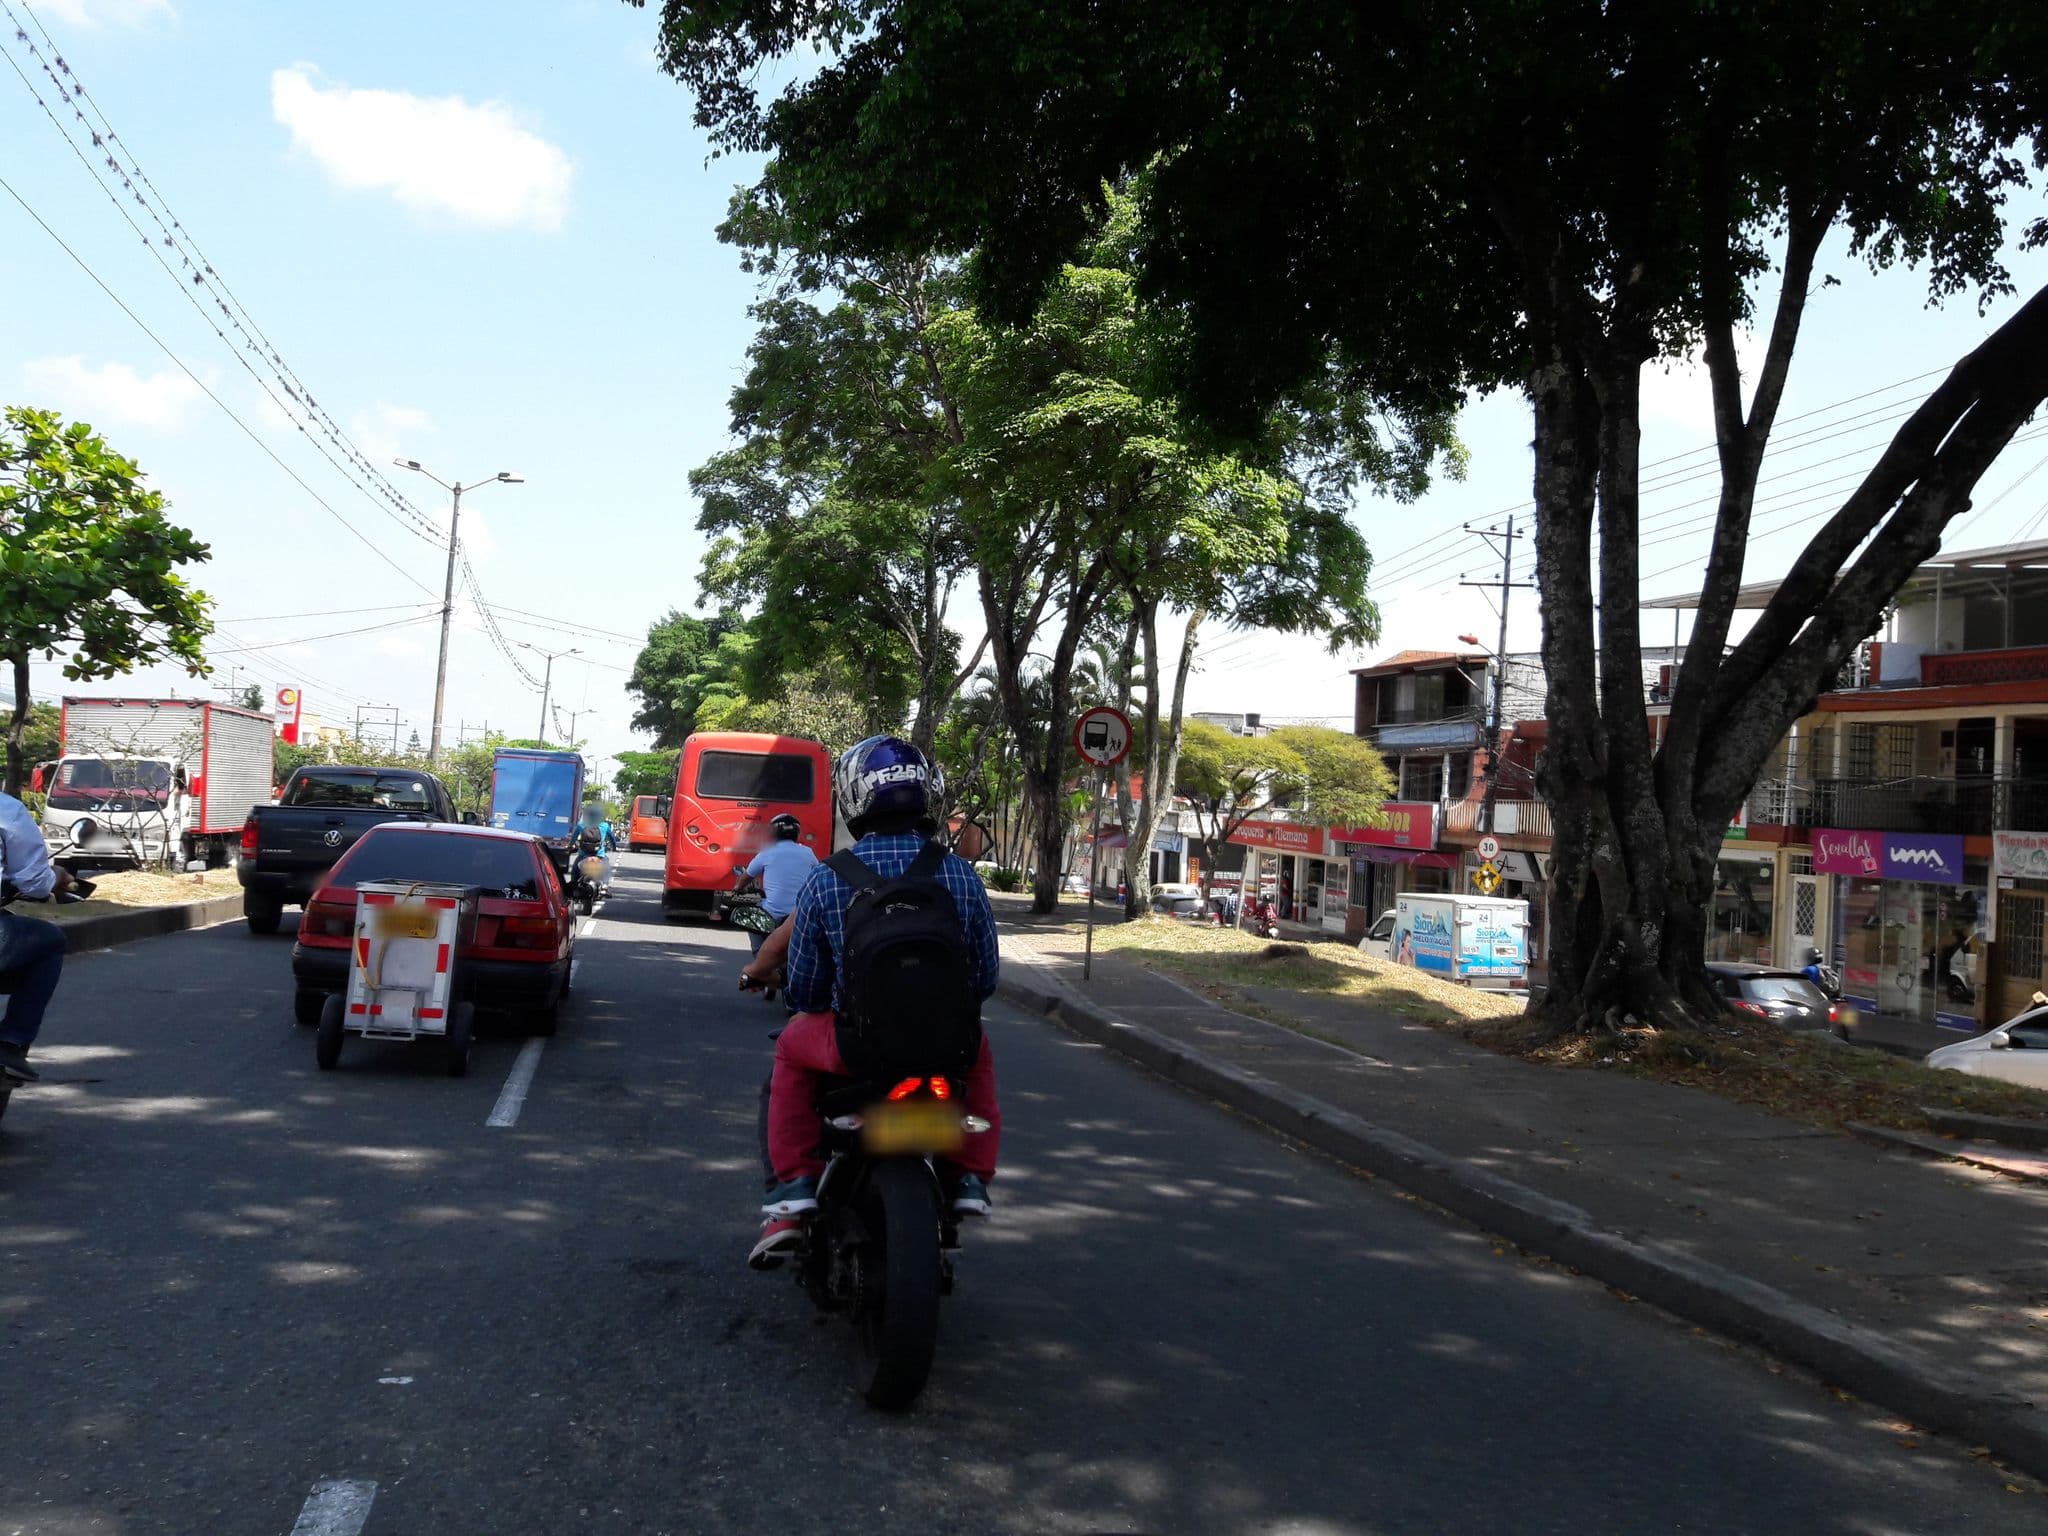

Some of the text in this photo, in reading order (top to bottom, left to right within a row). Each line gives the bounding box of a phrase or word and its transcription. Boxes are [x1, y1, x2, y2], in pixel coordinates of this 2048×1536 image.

[90, 803, 123, 811] JAC
[1275, 826, 1308, 843] Alemana
[1483, 842, 1494, 852] 30
[1479, 912, 1489, 921] 24
